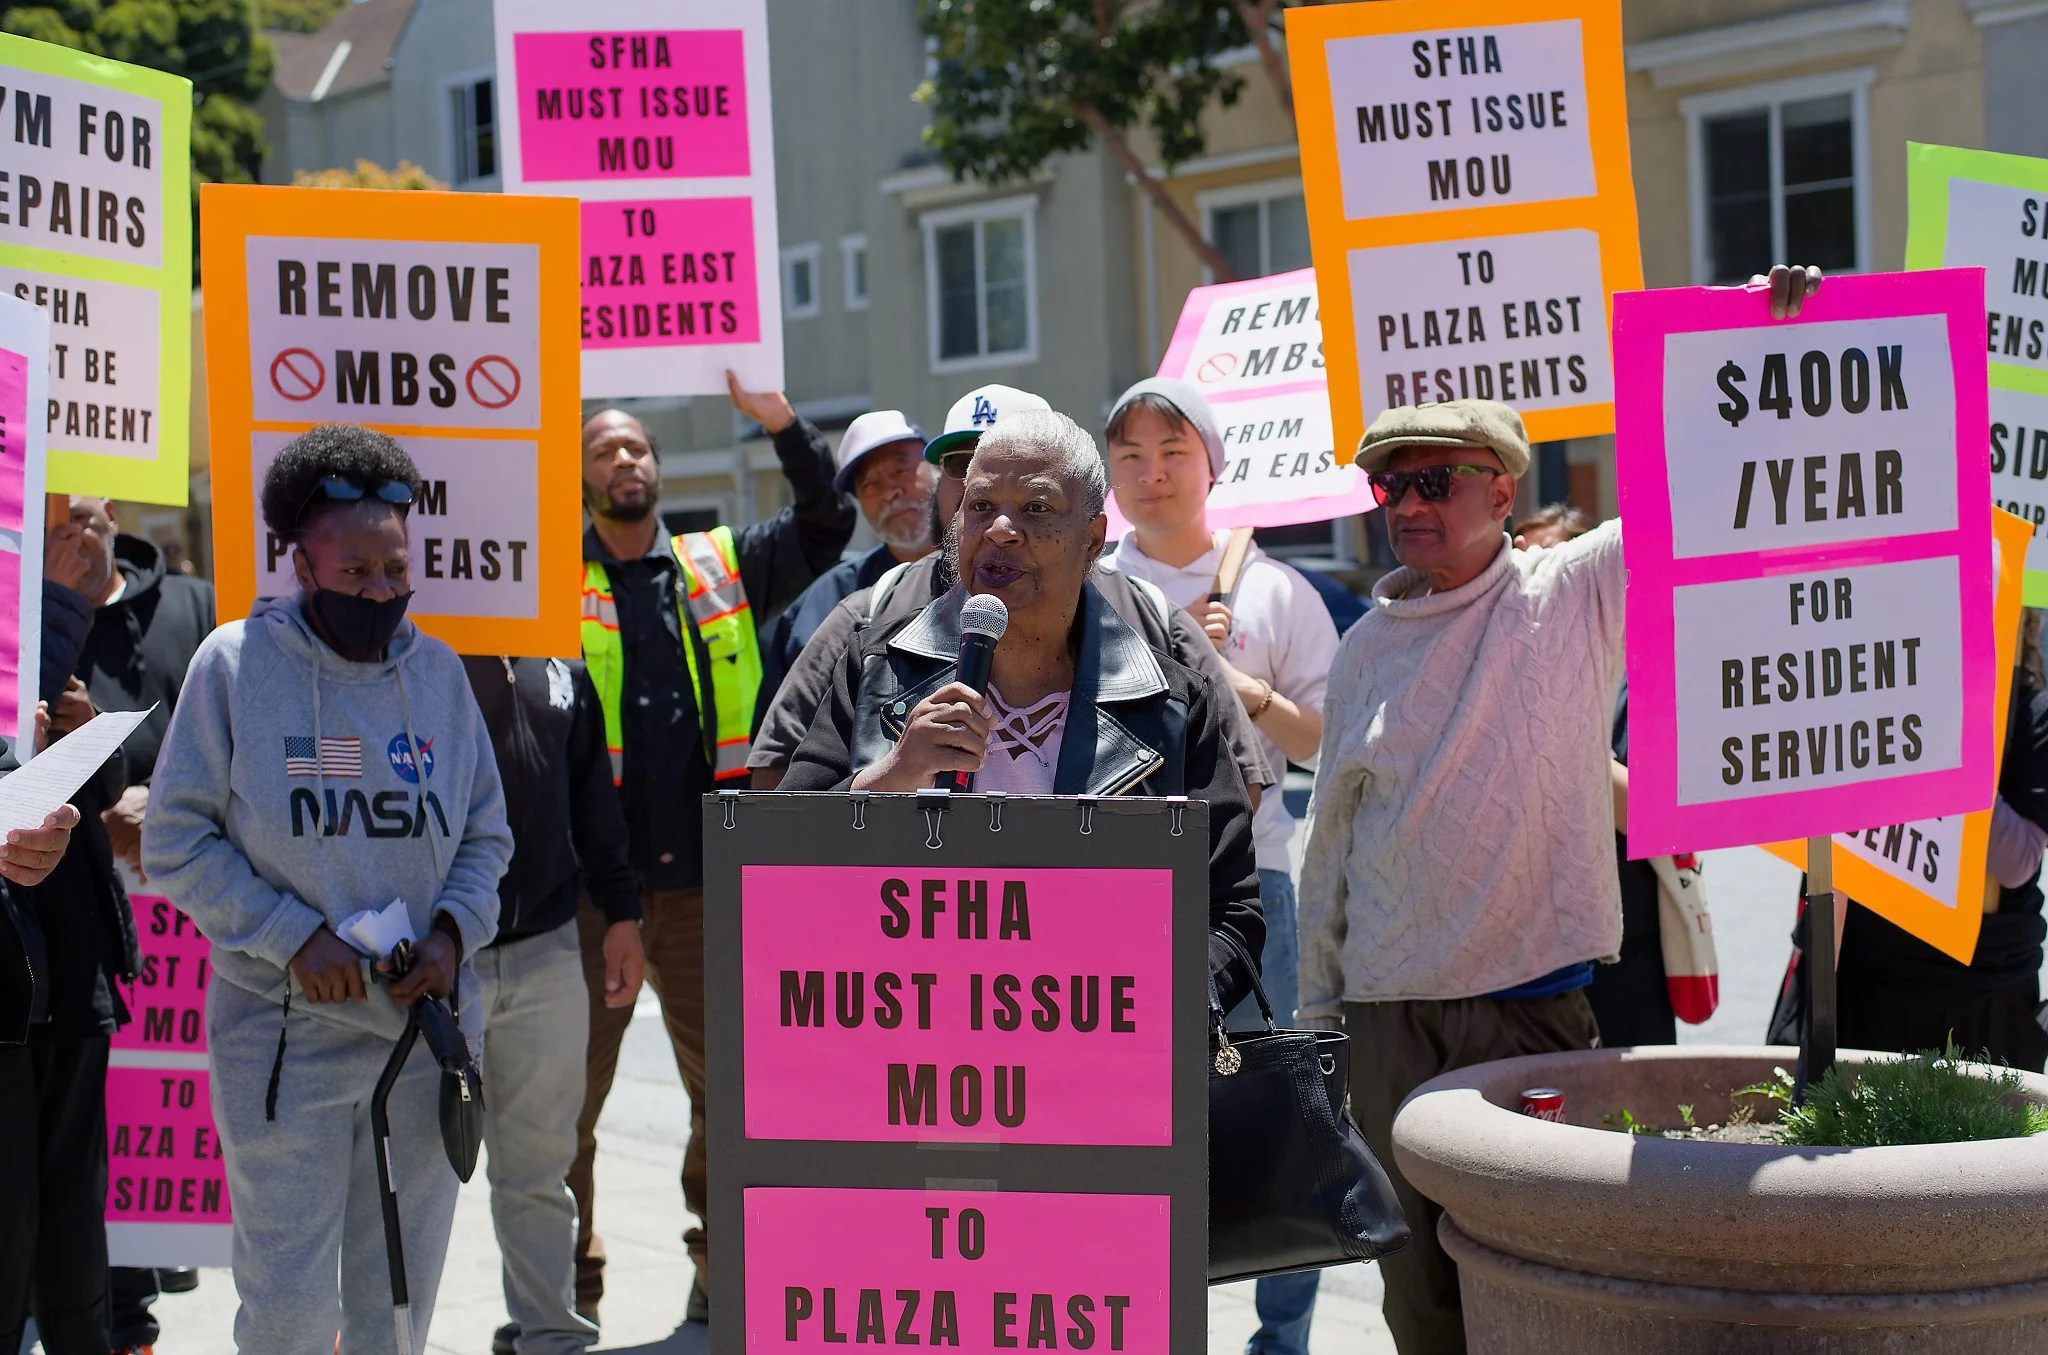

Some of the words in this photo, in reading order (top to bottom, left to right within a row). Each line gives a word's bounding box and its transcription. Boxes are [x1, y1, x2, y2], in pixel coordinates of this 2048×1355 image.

[590, 37, 670, 68] SFHA
[1413, 36, 1501, 78] SFHA
[537, 88, 621, 119] MUST
[641, 86, 728, 117] ISSUE
[1357, 100, 1451, 143] MUST
[1472, 91, 1566, 133] ISSUE
[80, 104, 150, 169] FOR
[599, 137, 672, 171] MOU
[1428, 155, 1510, 200] MOU
[624, 209, 655, 236] TO
[279, 260, 509, 323] REMOVE
[581, 256, 644, 286] AZA
[663, 252, 734, 283] EAST
[1458, 251, 1493, 285] TO
[1222, 297, 1318, 334] REM
[1379, 307, 1485, 351] PLAZA
[1503, 297, 1580, 338] EAST
[86, 349, 115, 384] BE
[336, 351, 456, 408] MBS
[1386, 354, 1588, 410] RESIDENTS
[1717, 345, 1908, 427] $400K
[1224, 419, 1302, 443] FROM
[1268, 450, 1346, 479] EAS
[1734, 450, 1902, 529] /YEAR
[425, 539, 526, 581] EAST
[1790, 578, 1851, 625] FOR
[1722, 638, 1920, 708] RESIDENT
[390, 752, 432, 765] NAA
[1722, 714, 1922, 785] SERVICES
[290, 787, 451, 837] NASA
[1845, 823, 1940, 884] ENTS
[151, 903, 202, 937] SF
[881, 879, 1030, 940] SFHA
[780, 971, 936, 1029] MUST
[971, 974, 1135, 1032] ISSUE
[162, 1079, 194, 1108] TO
[888, 1064, 1025, 1127] MOU
[115, 1177, 231, 1212] SIDEN
[926, 1208, 984, 1260] TO
[785, 1287, 959, 1346] PLAZA
[994, 1292, 1130, 1350] EAST
